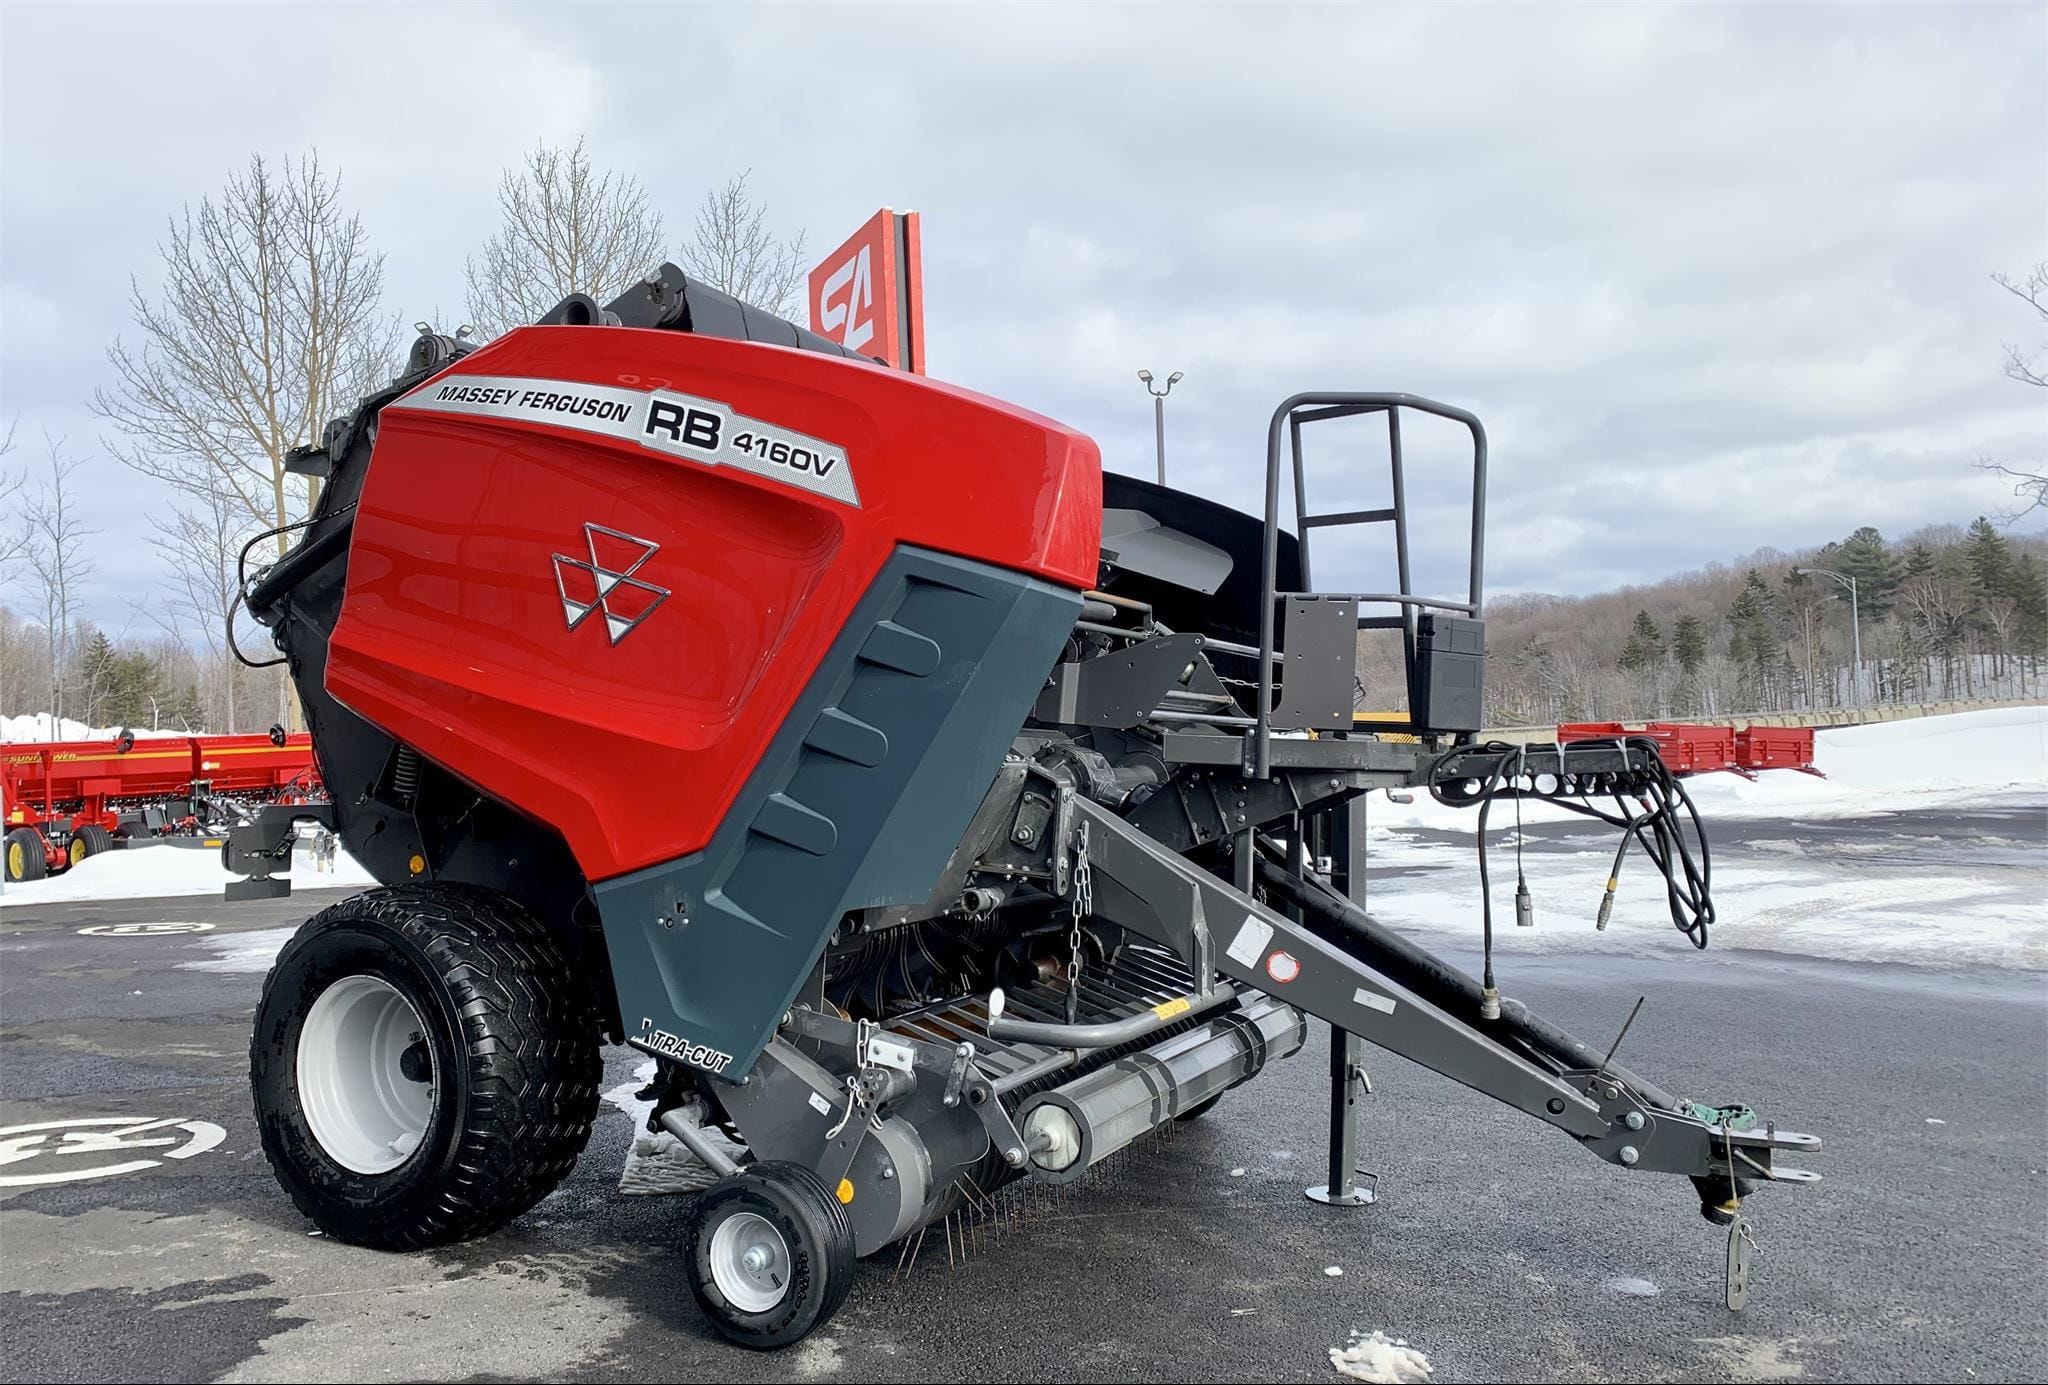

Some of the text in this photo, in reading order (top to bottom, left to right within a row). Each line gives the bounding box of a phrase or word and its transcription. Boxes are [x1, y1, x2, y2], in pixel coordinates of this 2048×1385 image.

[436, 386, 836, 477] MASSEY FERGUSON RB 4160V
[8, 753, 77, 763] SUNFWER
